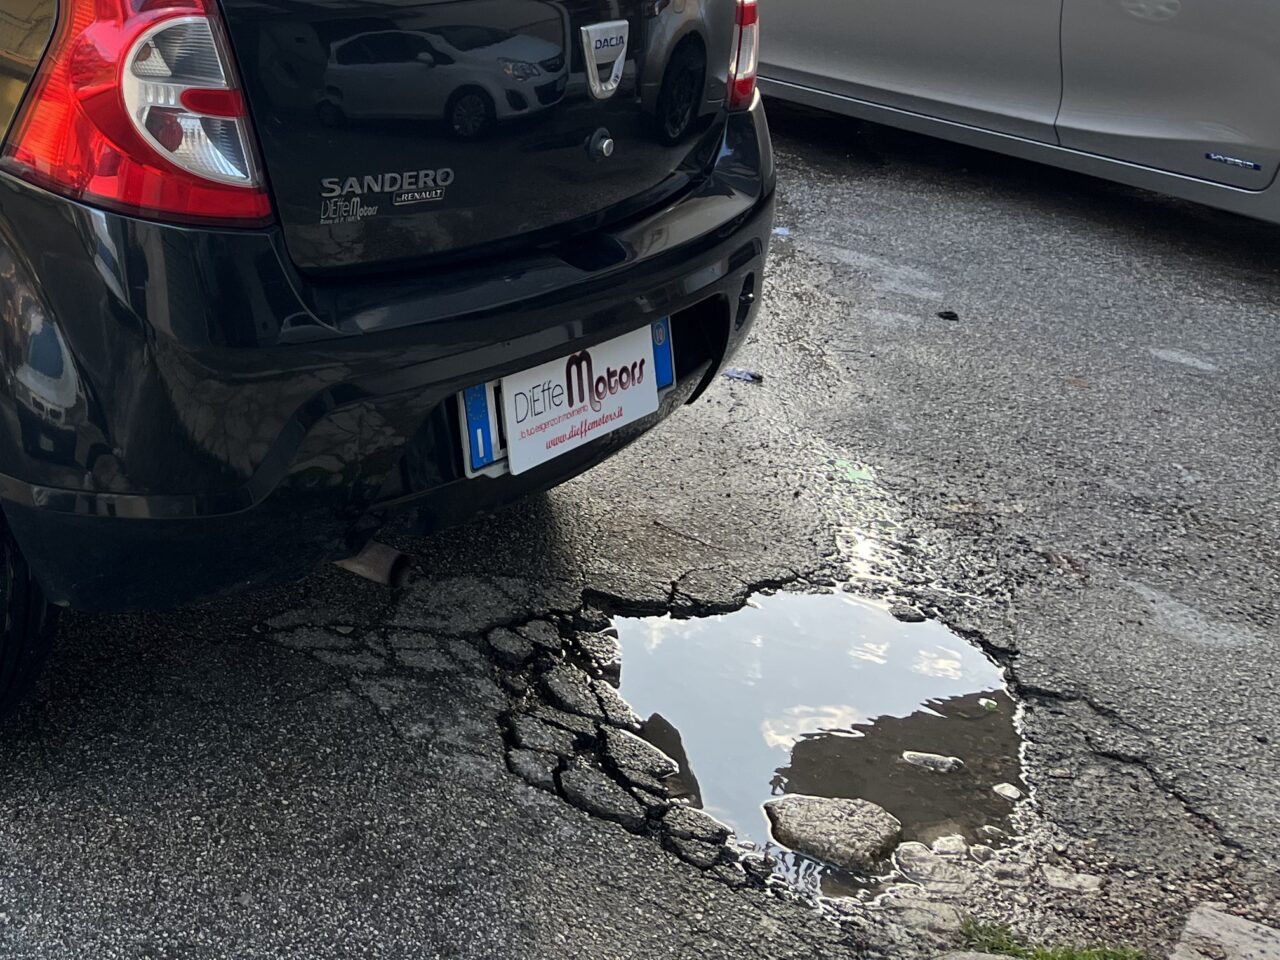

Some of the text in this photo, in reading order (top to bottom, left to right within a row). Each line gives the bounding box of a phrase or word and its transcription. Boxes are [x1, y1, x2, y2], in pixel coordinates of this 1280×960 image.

[594, 35, 625, 50] DACIA
[321, 168, 454, 197] SANDERO
[401, 189, 442, 201] RENAULT
[565, 349, 646, 413] Motors
[545, 405, 624, 450] www.dieffemotors.it
